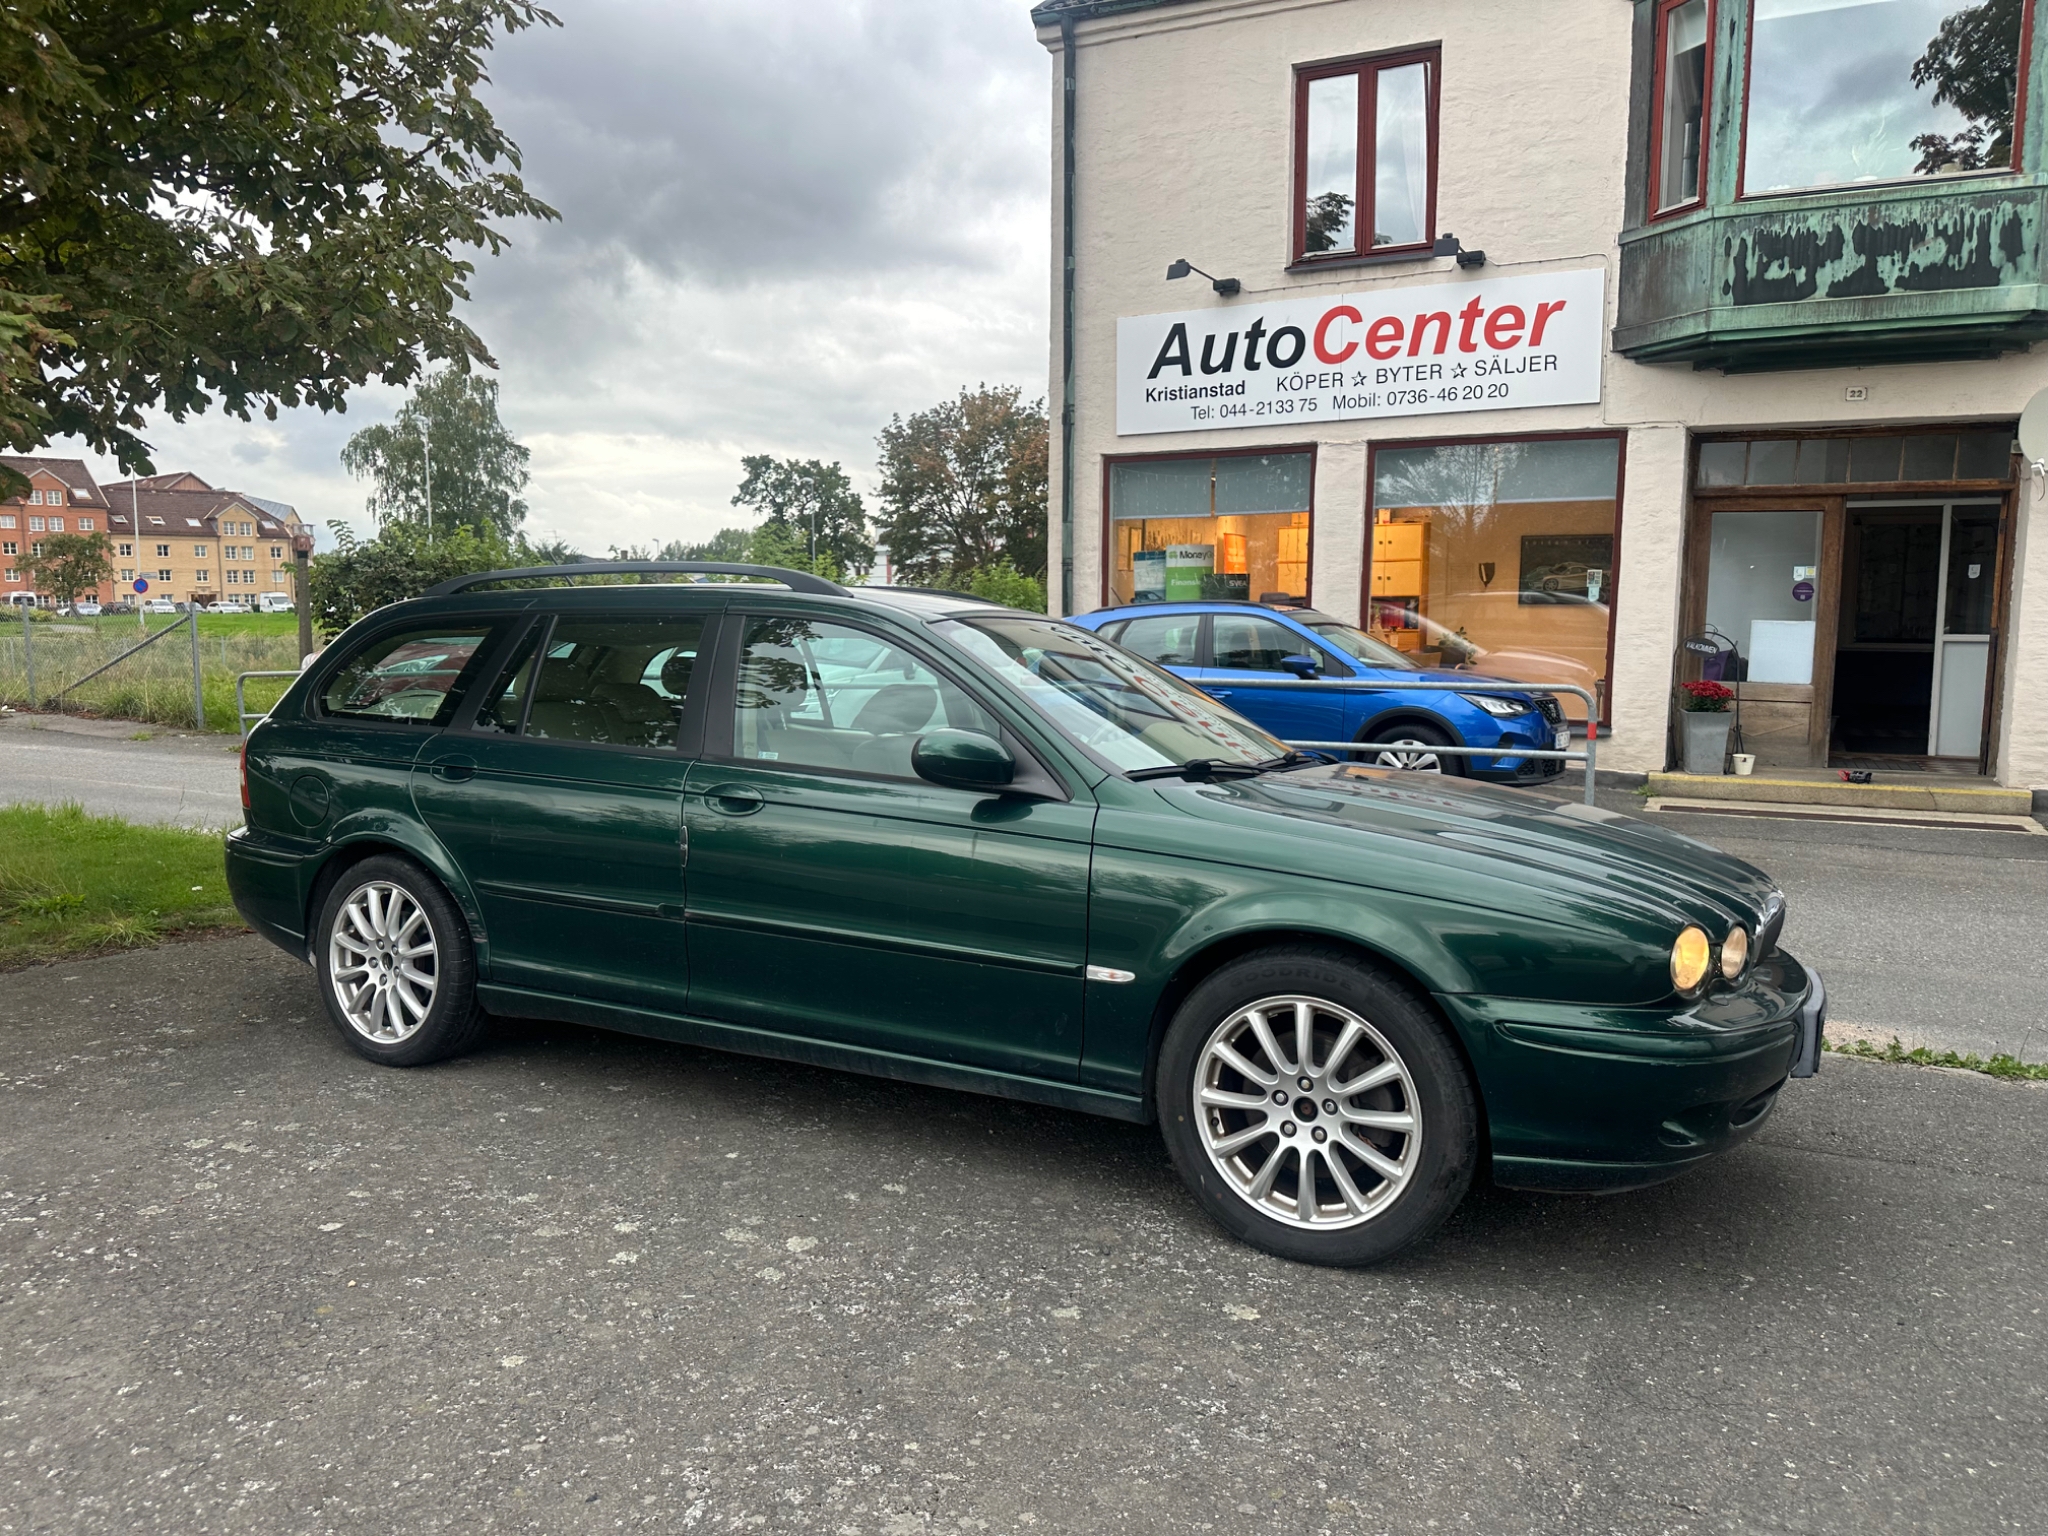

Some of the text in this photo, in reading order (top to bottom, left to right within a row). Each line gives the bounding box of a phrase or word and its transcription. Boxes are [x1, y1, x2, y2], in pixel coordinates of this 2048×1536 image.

[1147, 294, 1567, 379] AutoCenter
[1277, 354, 1557, 392] KÖPER BYTER SÄLJER
[1146, 380, 1245, 402] Kristianstad
[1850, 390, 1863, 398] 22
[1191, 405, 1215, 420] Tel:
[1333, 392, 1381, 409] Mobil:
[1230, 968, 1353, 991] GOODRIDE
